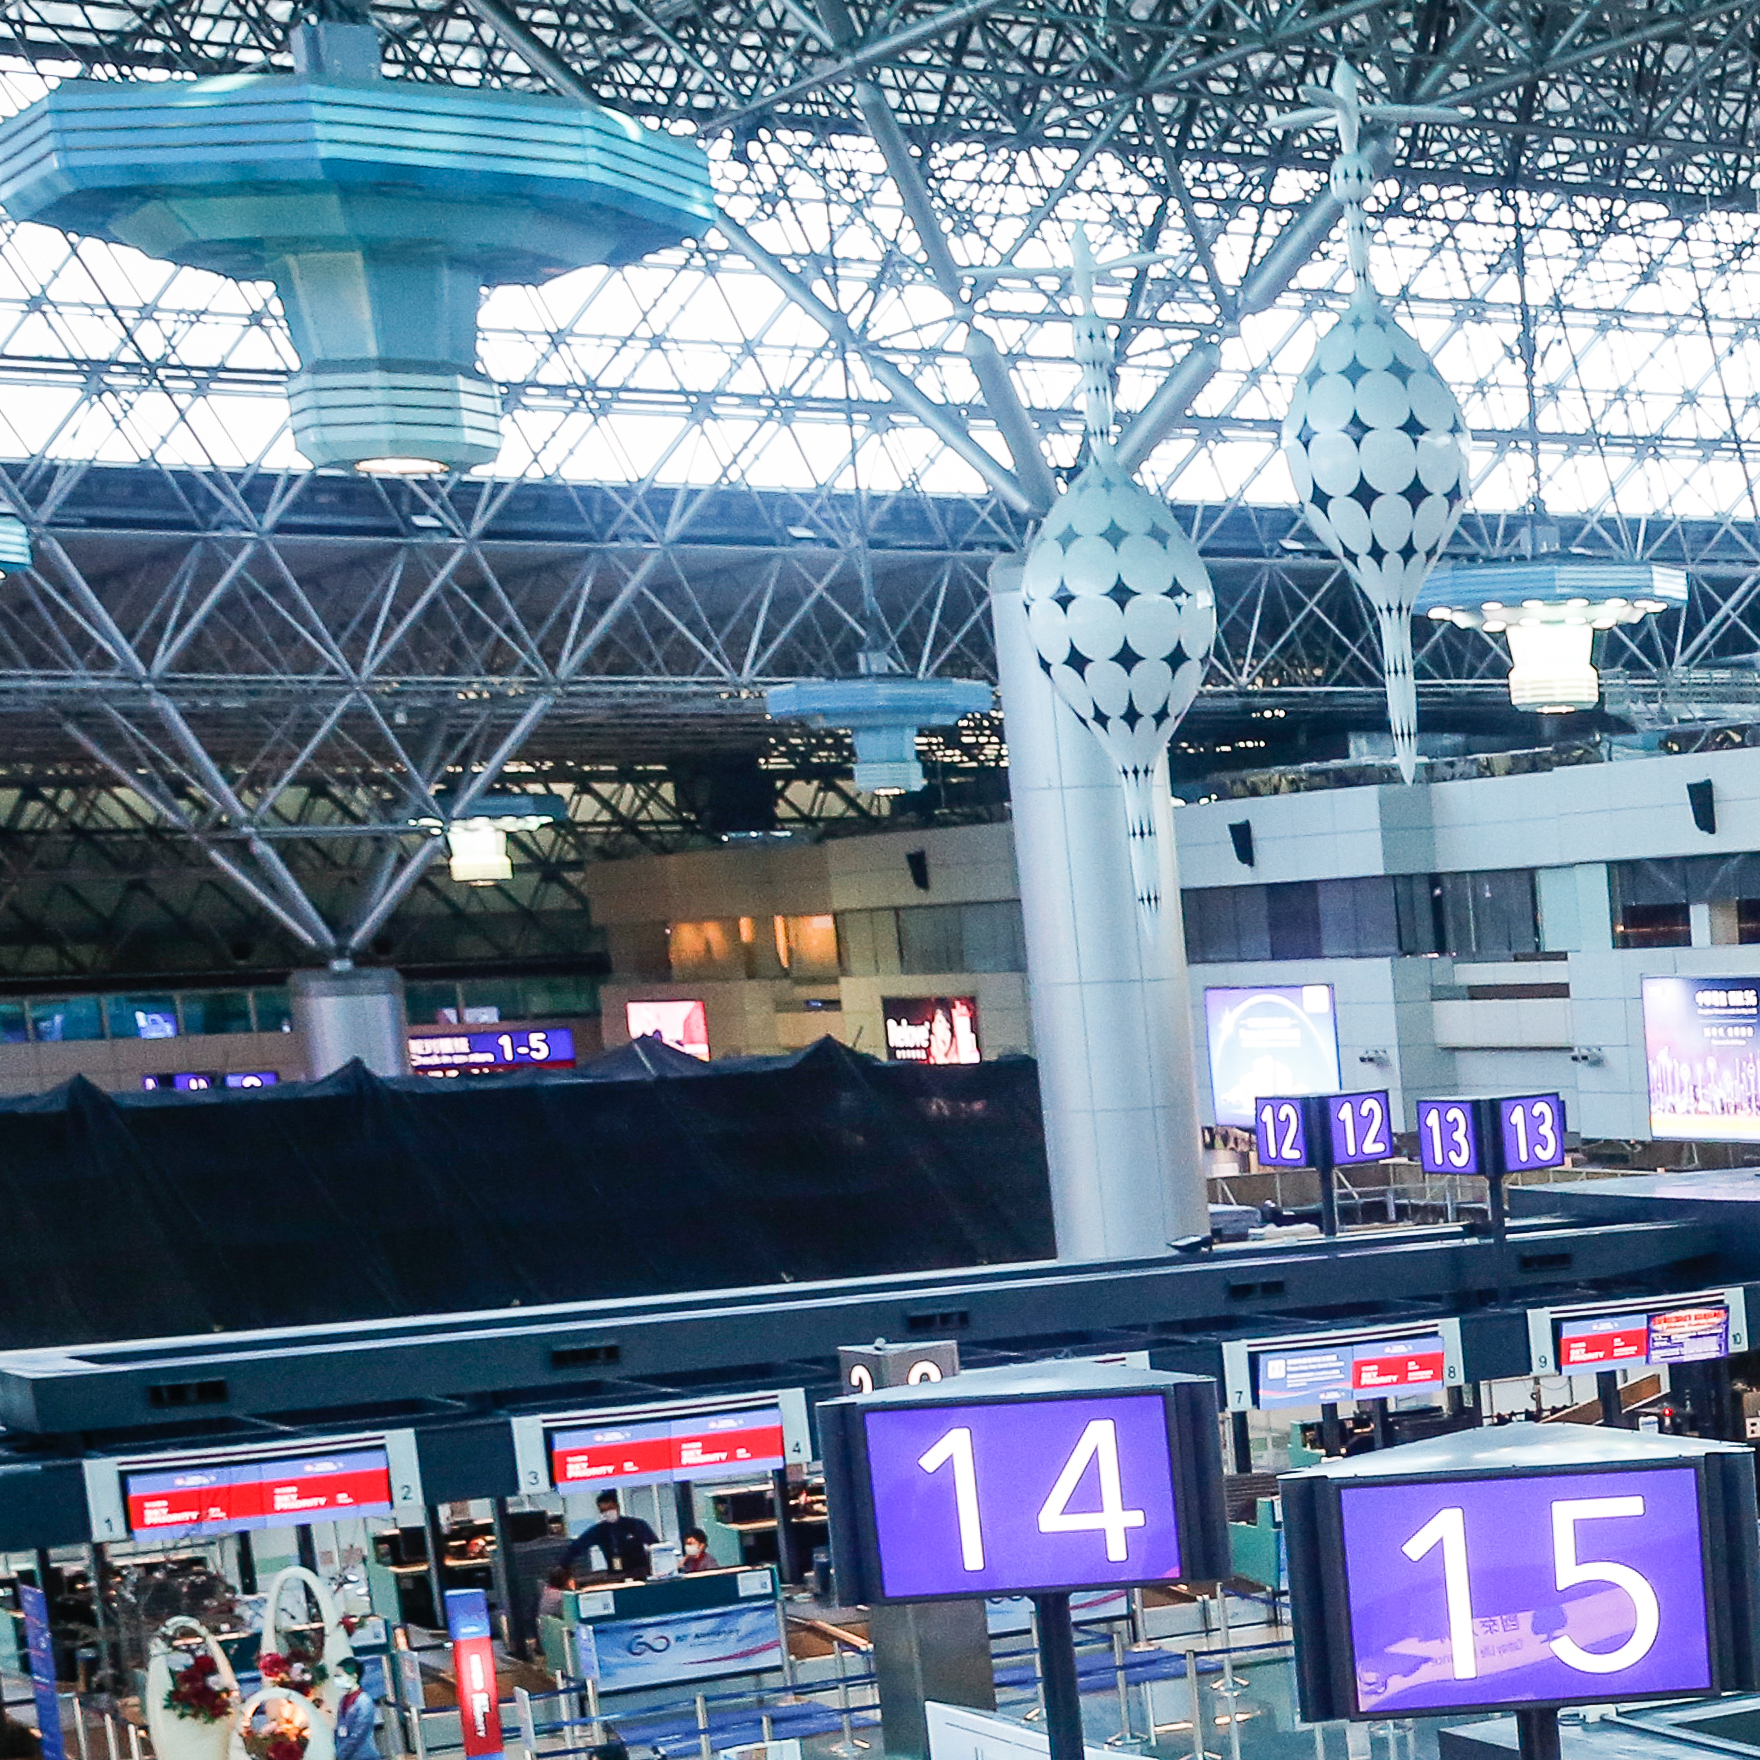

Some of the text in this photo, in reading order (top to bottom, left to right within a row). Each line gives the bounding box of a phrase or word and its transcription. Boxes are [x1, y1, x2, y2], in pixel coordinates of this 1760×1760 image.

[497, 1032, 549, 1062] 1-5
[1260, 1104, 1302, 1159] 12
[1338, 1099, 1386, 1156] 12
[1509, 1101, 1557, 1164] 13
[1424, 1107, 1471, 1169] 13
[1733, 1333, 1742, 1345] 10
[1539, 1355, 1547, 1369] 9
[1448, 1365, 1456, 1379] 8
[1234, 1390, 1243, 1404] 7
[792, 1441, 801, 1455] 4
[529, 1471, 539, 1485] 3
[401, 1485, 412, 1500] 2
[918, 1418, 1146, 1572] 14
[106, 1519, 112, 1532] 1
[1401, 1494, 1660, 1680] 15
